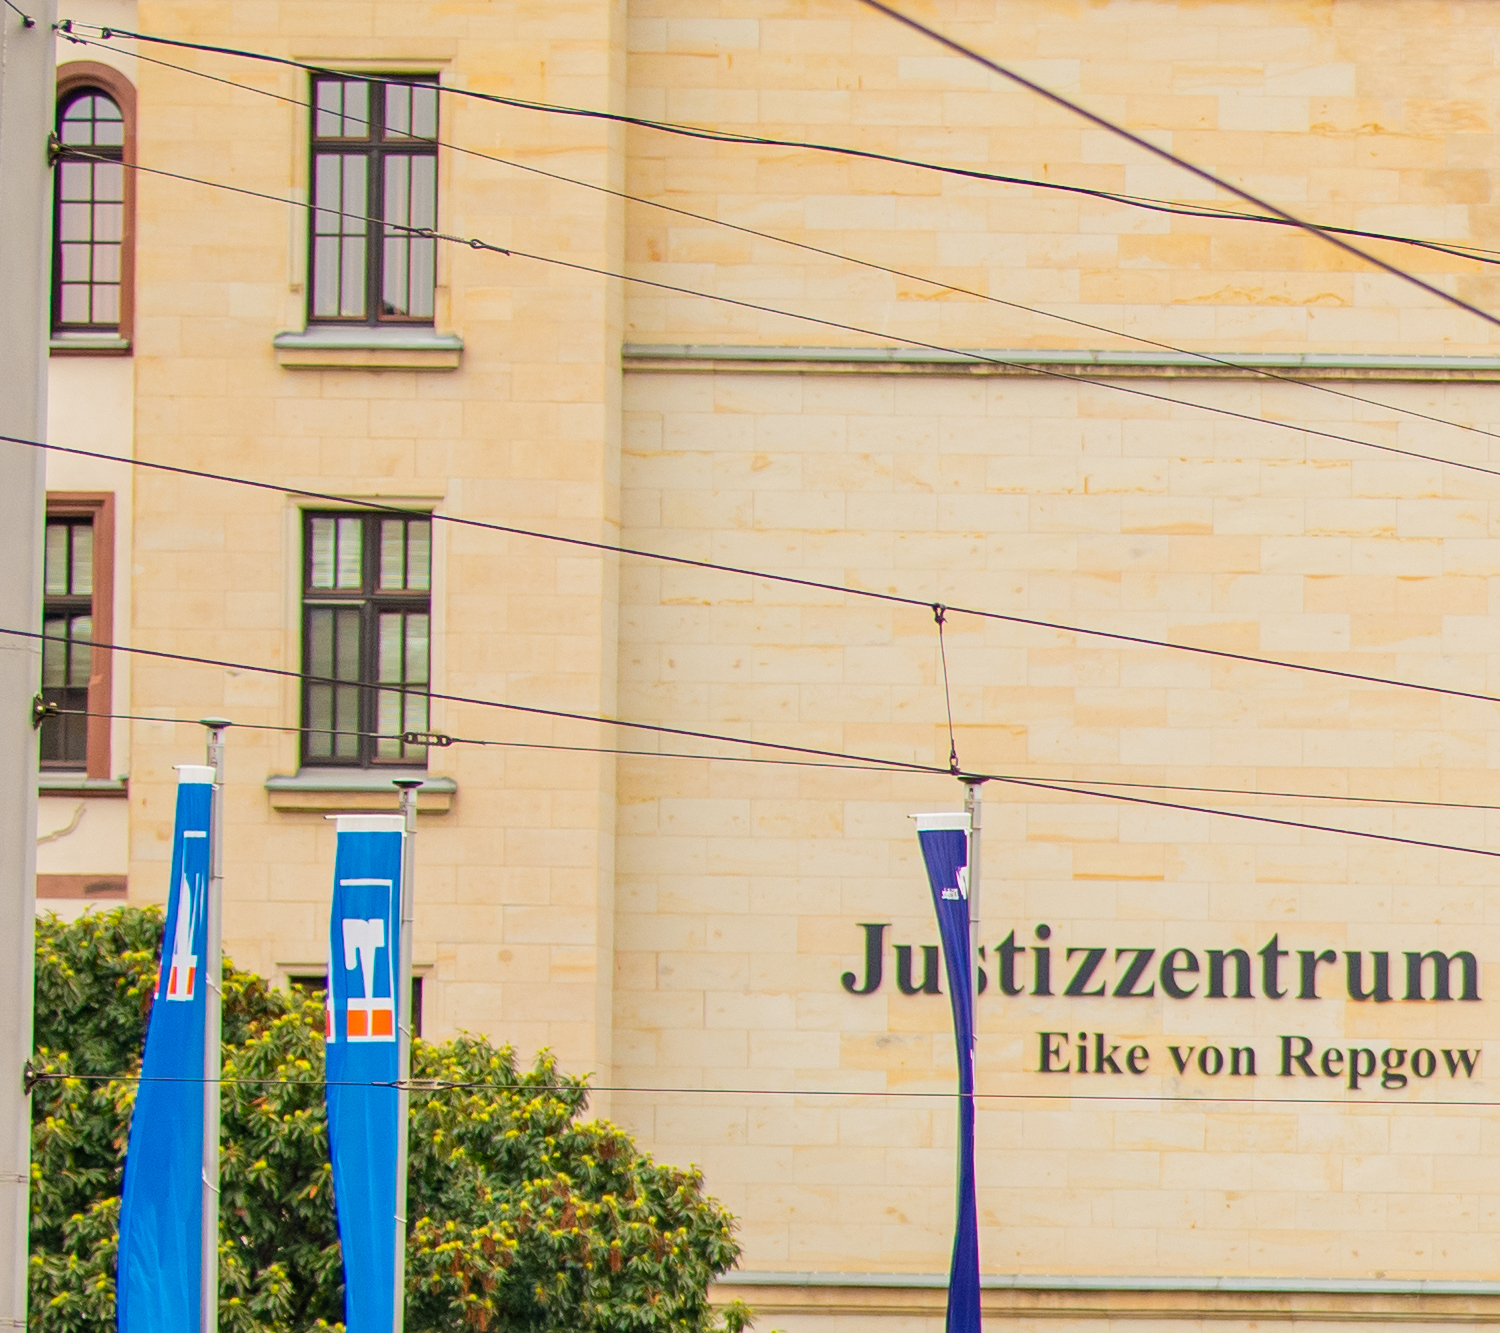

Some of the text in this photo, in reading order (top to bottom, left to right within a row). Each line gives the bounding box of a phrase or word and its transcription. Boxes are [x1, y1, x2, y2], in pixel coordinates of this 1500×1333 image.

[841, 922, 1482, 1002] Justizzentrum
[1037, 1030, 1482, 1090] Eike von Repgow
